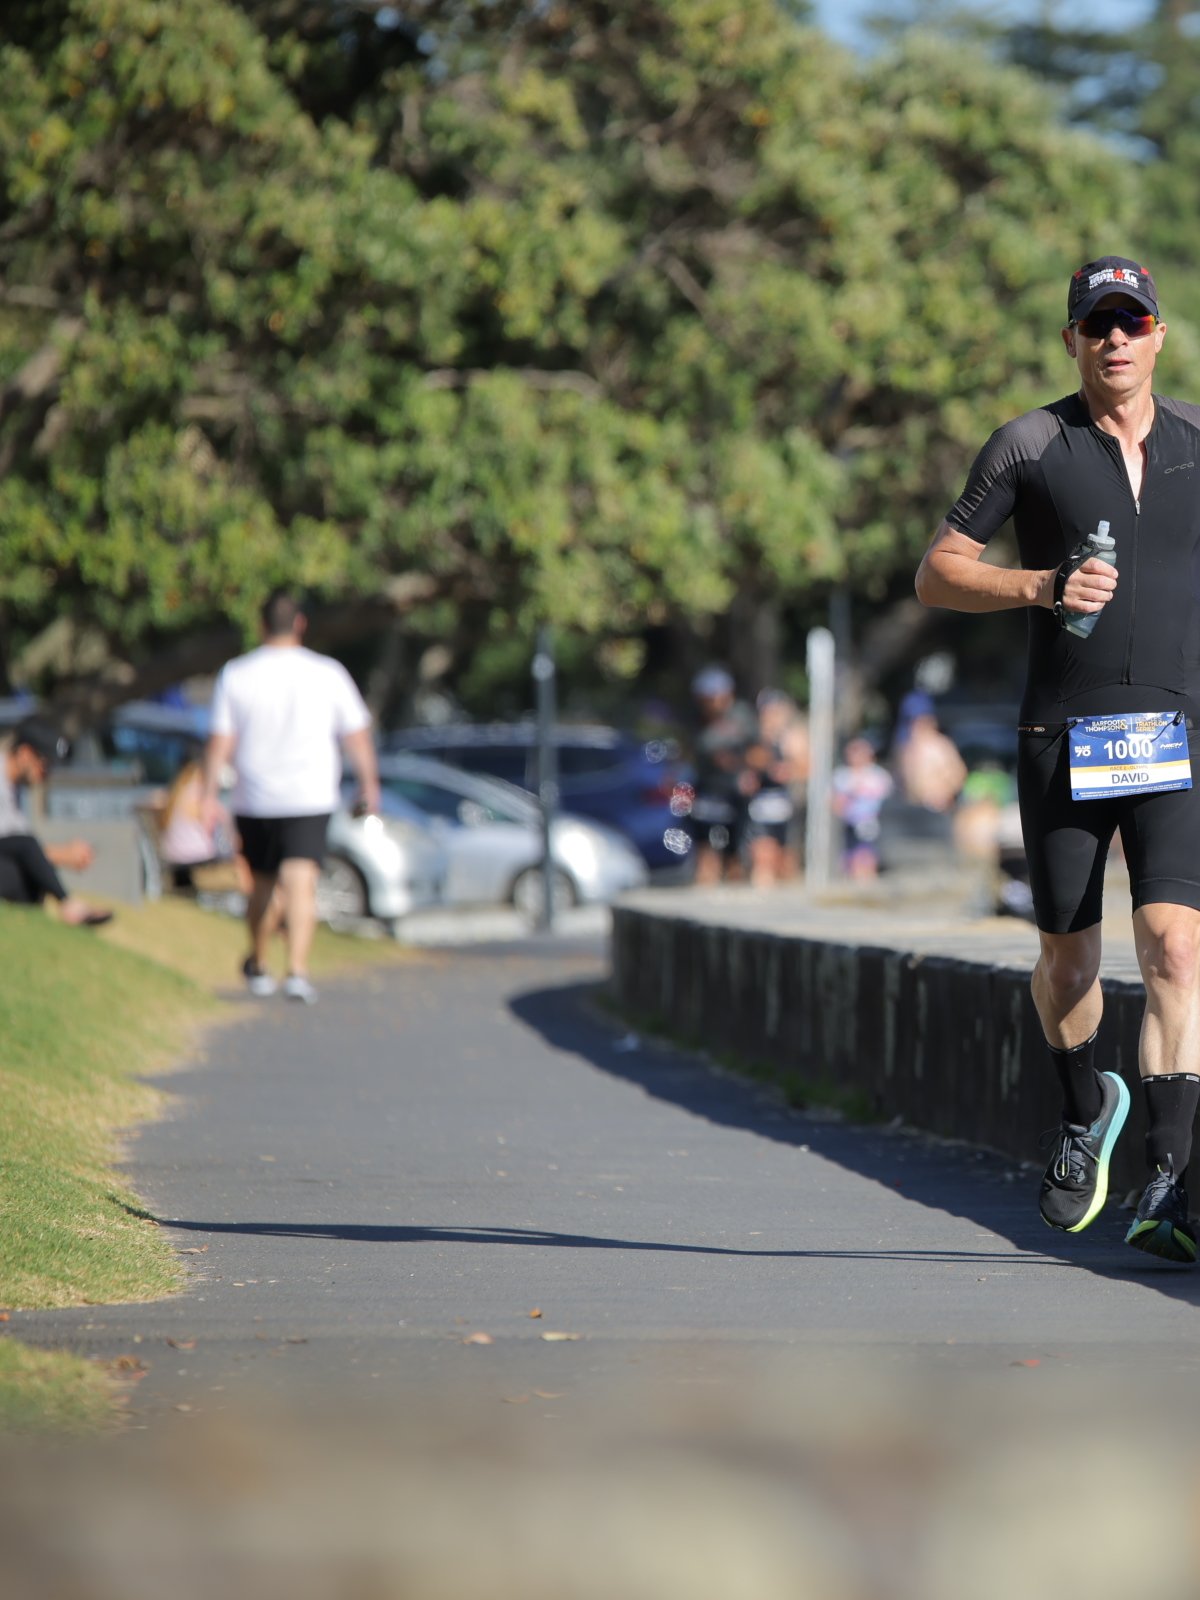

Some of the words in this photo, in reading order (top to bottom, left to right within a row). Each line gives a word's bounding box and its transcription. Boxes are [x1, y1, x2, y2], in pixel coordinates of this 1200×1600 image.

[1164, 462, 1194, 474] orca
[1075, 749, 1091, 757] 70
[1103, 740, 1153, 759] 1000
[1112, 773, 1149, 784] DAVID
